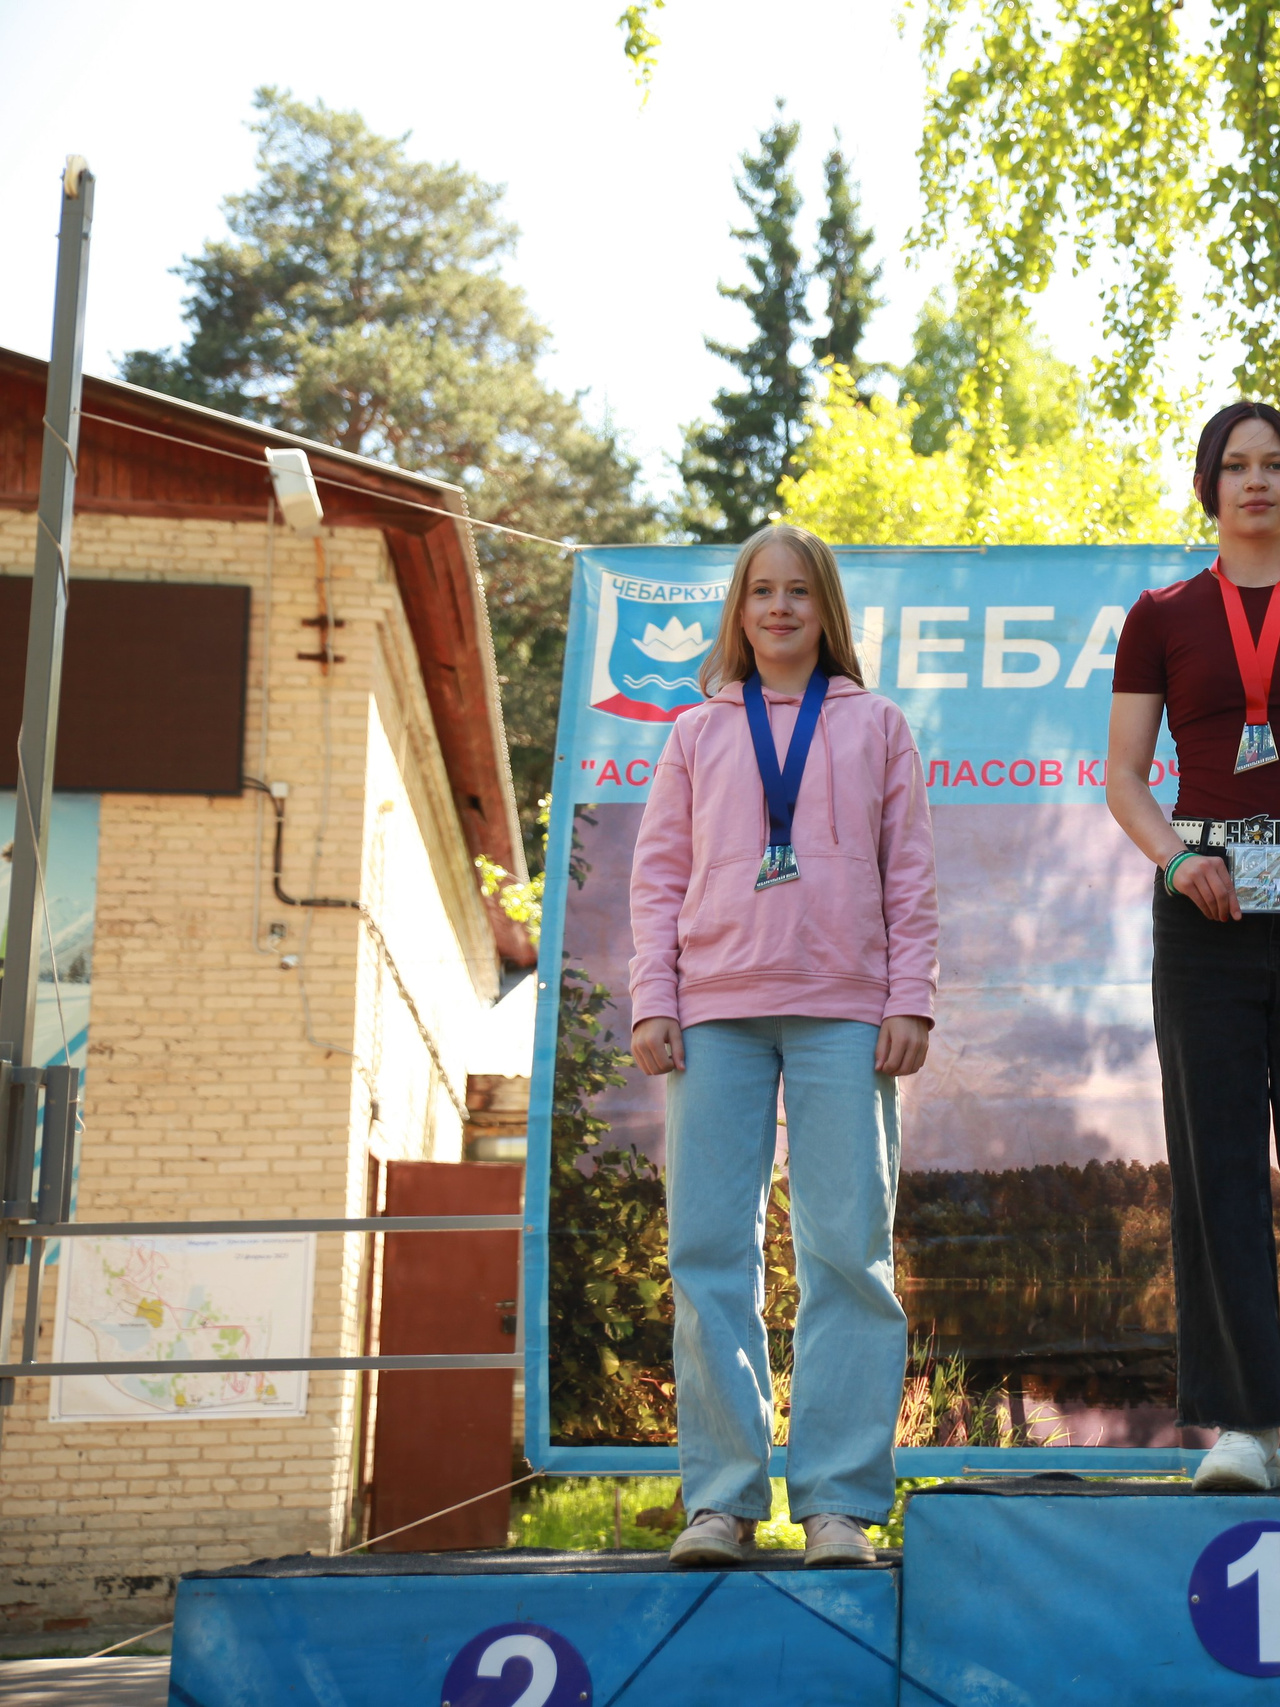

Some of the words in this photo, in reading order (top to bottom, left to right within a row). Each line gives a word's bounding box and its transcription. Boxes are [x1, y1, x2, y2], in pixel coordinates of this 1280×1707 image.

[612, 578, 728, 601] ЧЕБАРКУЛ
[926, 759, 1064, 787] ЛАСОВ
[477, 1634, 558, 1707] 2
